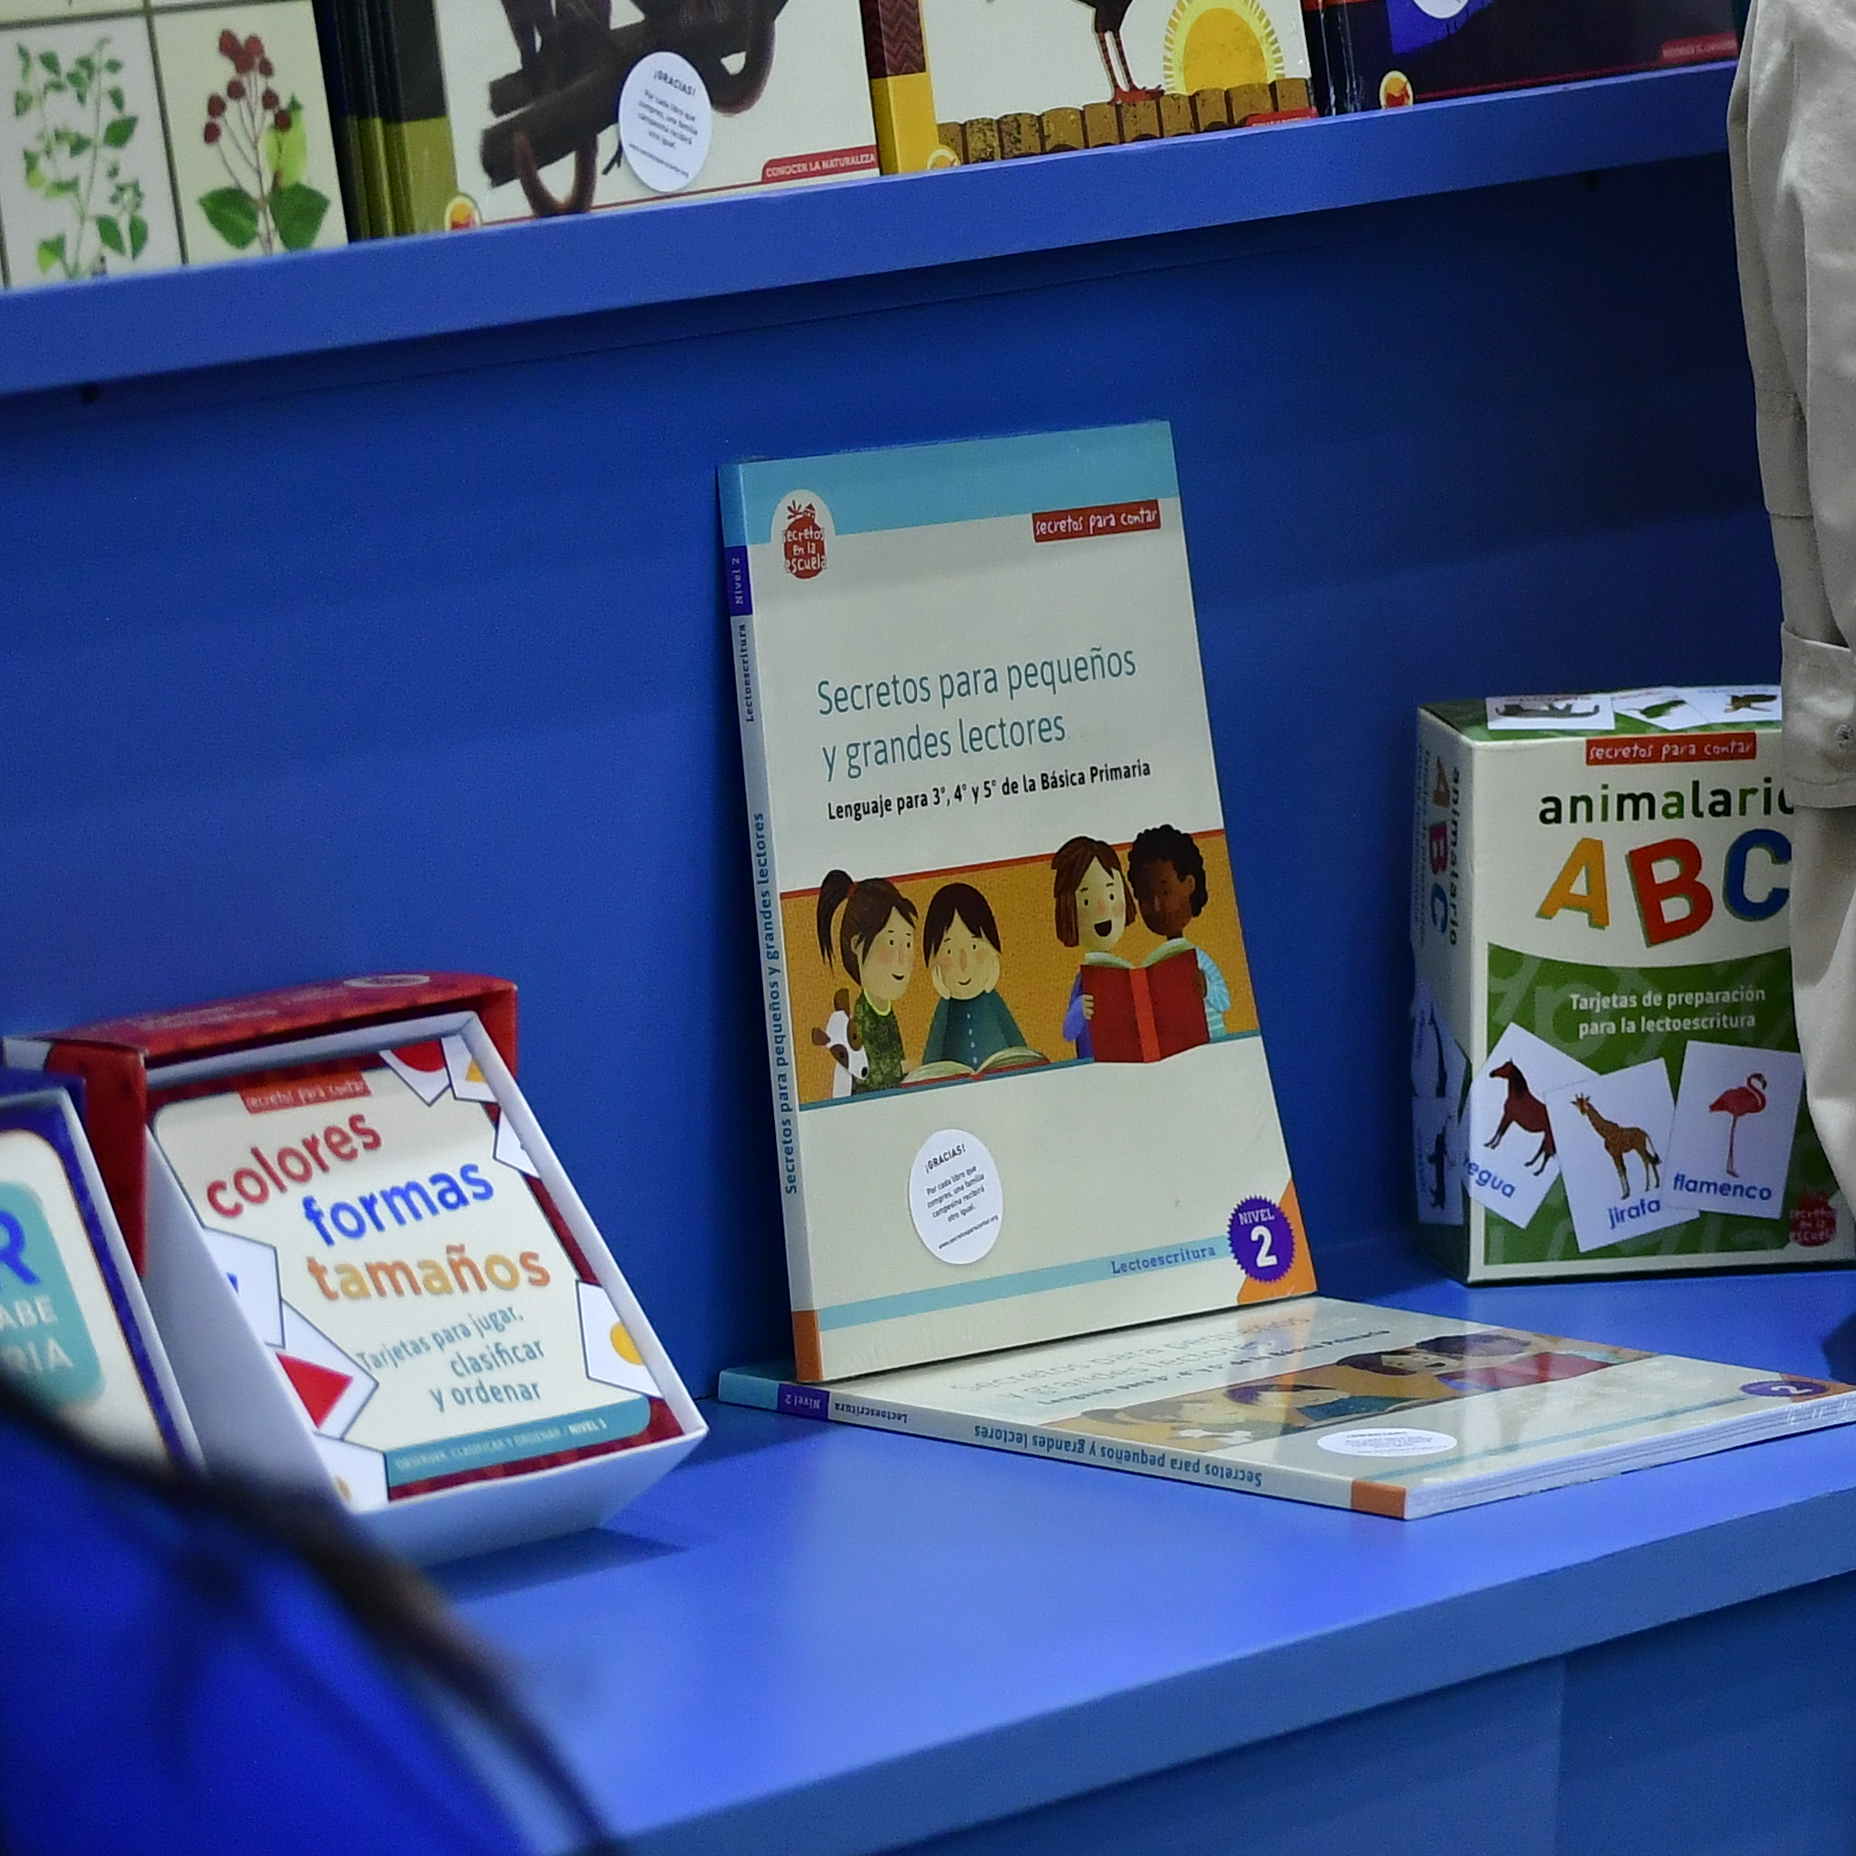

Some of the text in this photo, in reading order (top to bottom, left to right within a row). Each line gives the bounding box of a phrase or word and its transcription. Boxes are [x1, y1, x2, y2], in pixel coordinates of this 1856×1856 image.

[1035, 508, 1158, 536] secretos para contar
[817, 647, 1137, 717] Secretos para pequeños
[822, 714, 1067, 783] y grandes lectores
[828, 791, 893, 821] Lenguaje
[896, 792, 929, 816] para
[972, 785, 980, 805] y
[1002, 775, 1020, 797] de
[1023, 774, 1037, 793] la
[1040, 765, 1087, 791] Básica
[1090, 758, 1152, 784] Primaria
[1535, 827, 1794, 949] ABC
[1570, 985, 1766, 1012] Tarjetas de preparación
[1578, 1013, 1756, 1039] para la lectoescritura
[205, 1112, 383, 1221] colores
[302, 1161, 495, 1247] formas
[1672, 1173, 1773, 1202] flamenco
[1238, 1208, 1276, 1227] NIVEL
[1607, 1197, 1662, 1230] jirafa
[1112, 1244, 1217, 1275] Lectoescritura
[1249, 1225, 1279, 1268] 2
[306, 1244, 552, 1302] tamaños
[356, 1305, 524, 1371] Tarjetas para jugar,
[450, 1339, 545, 1378] clasificar
[430, 1377, 541, 1413] y ordenar
